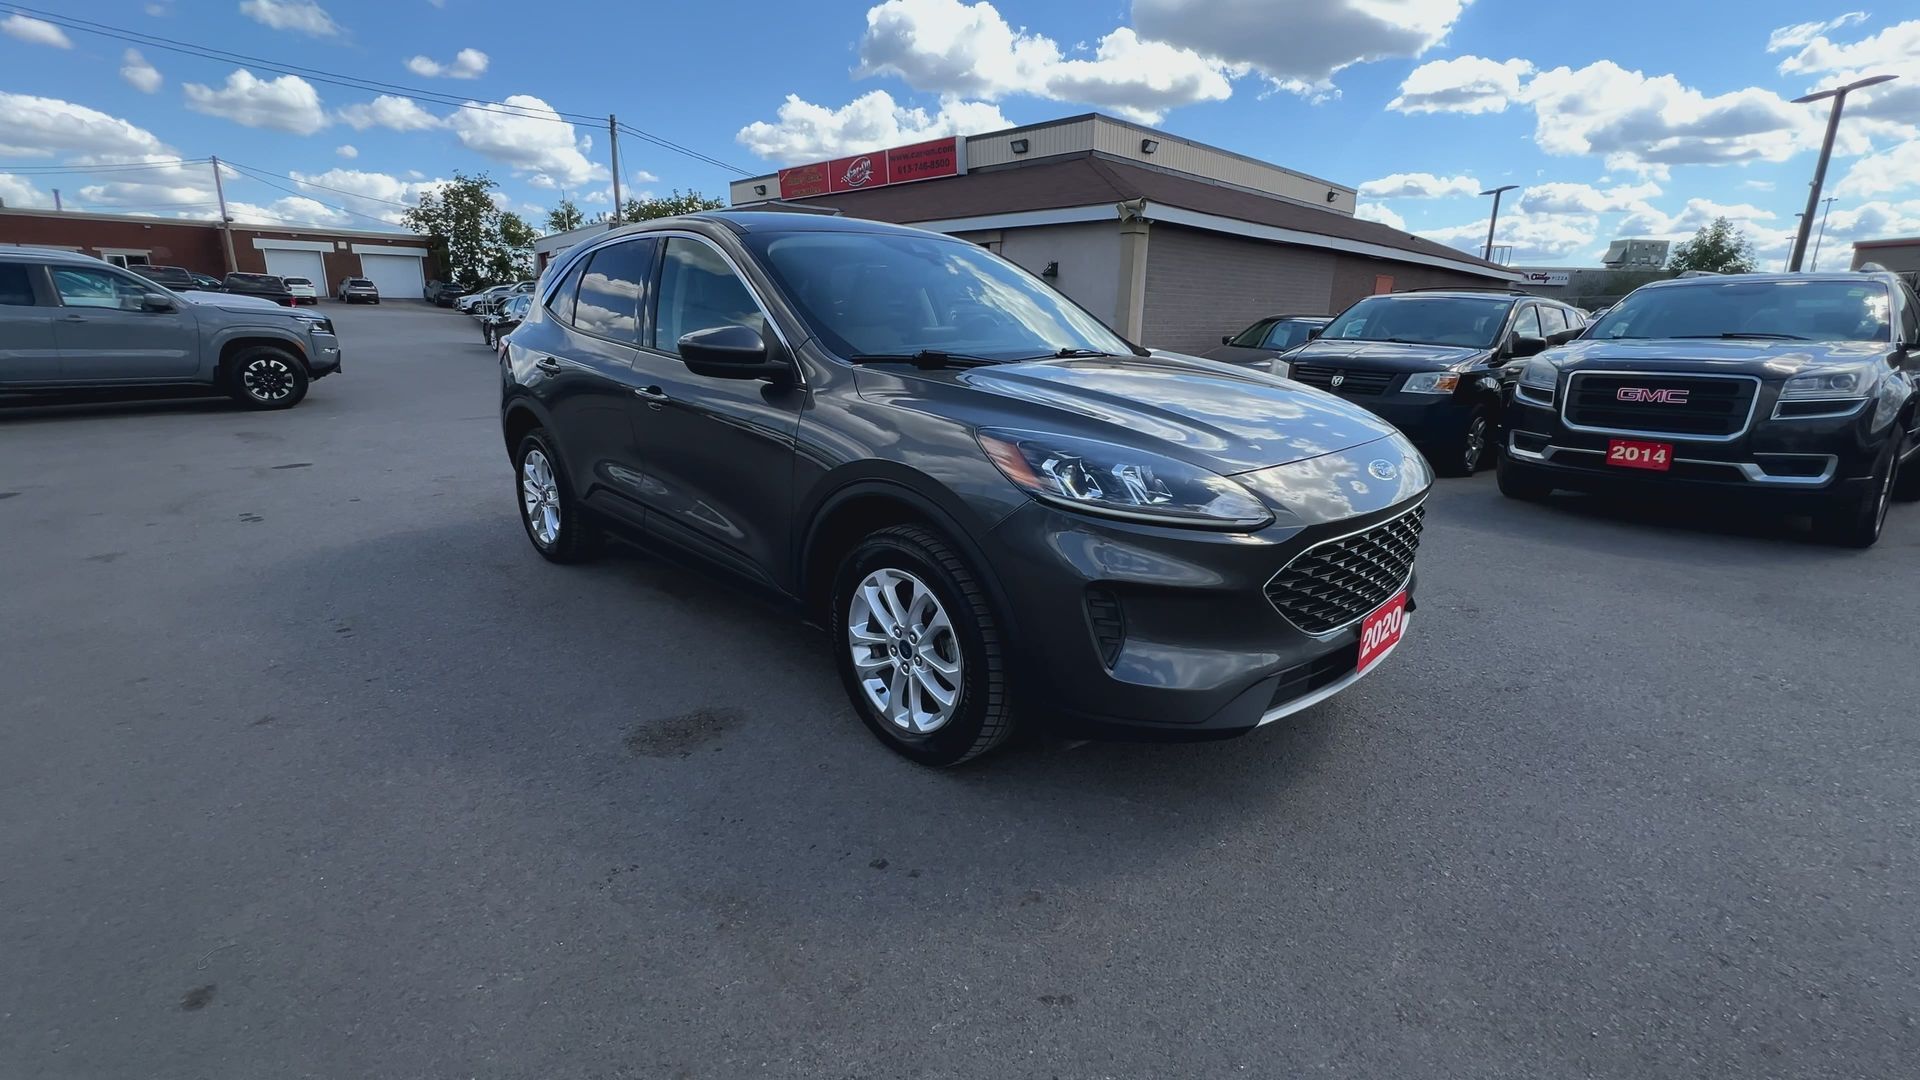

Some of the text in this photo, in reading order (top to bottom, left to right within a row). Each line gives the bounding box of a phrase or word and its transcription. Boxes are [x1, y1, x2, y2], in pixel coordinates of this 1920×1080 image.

[1616, 387, 1690, 404] GMC
[1610, 445, 1666, 463] 2014
[1360, 605, 1402, 660] 2020
